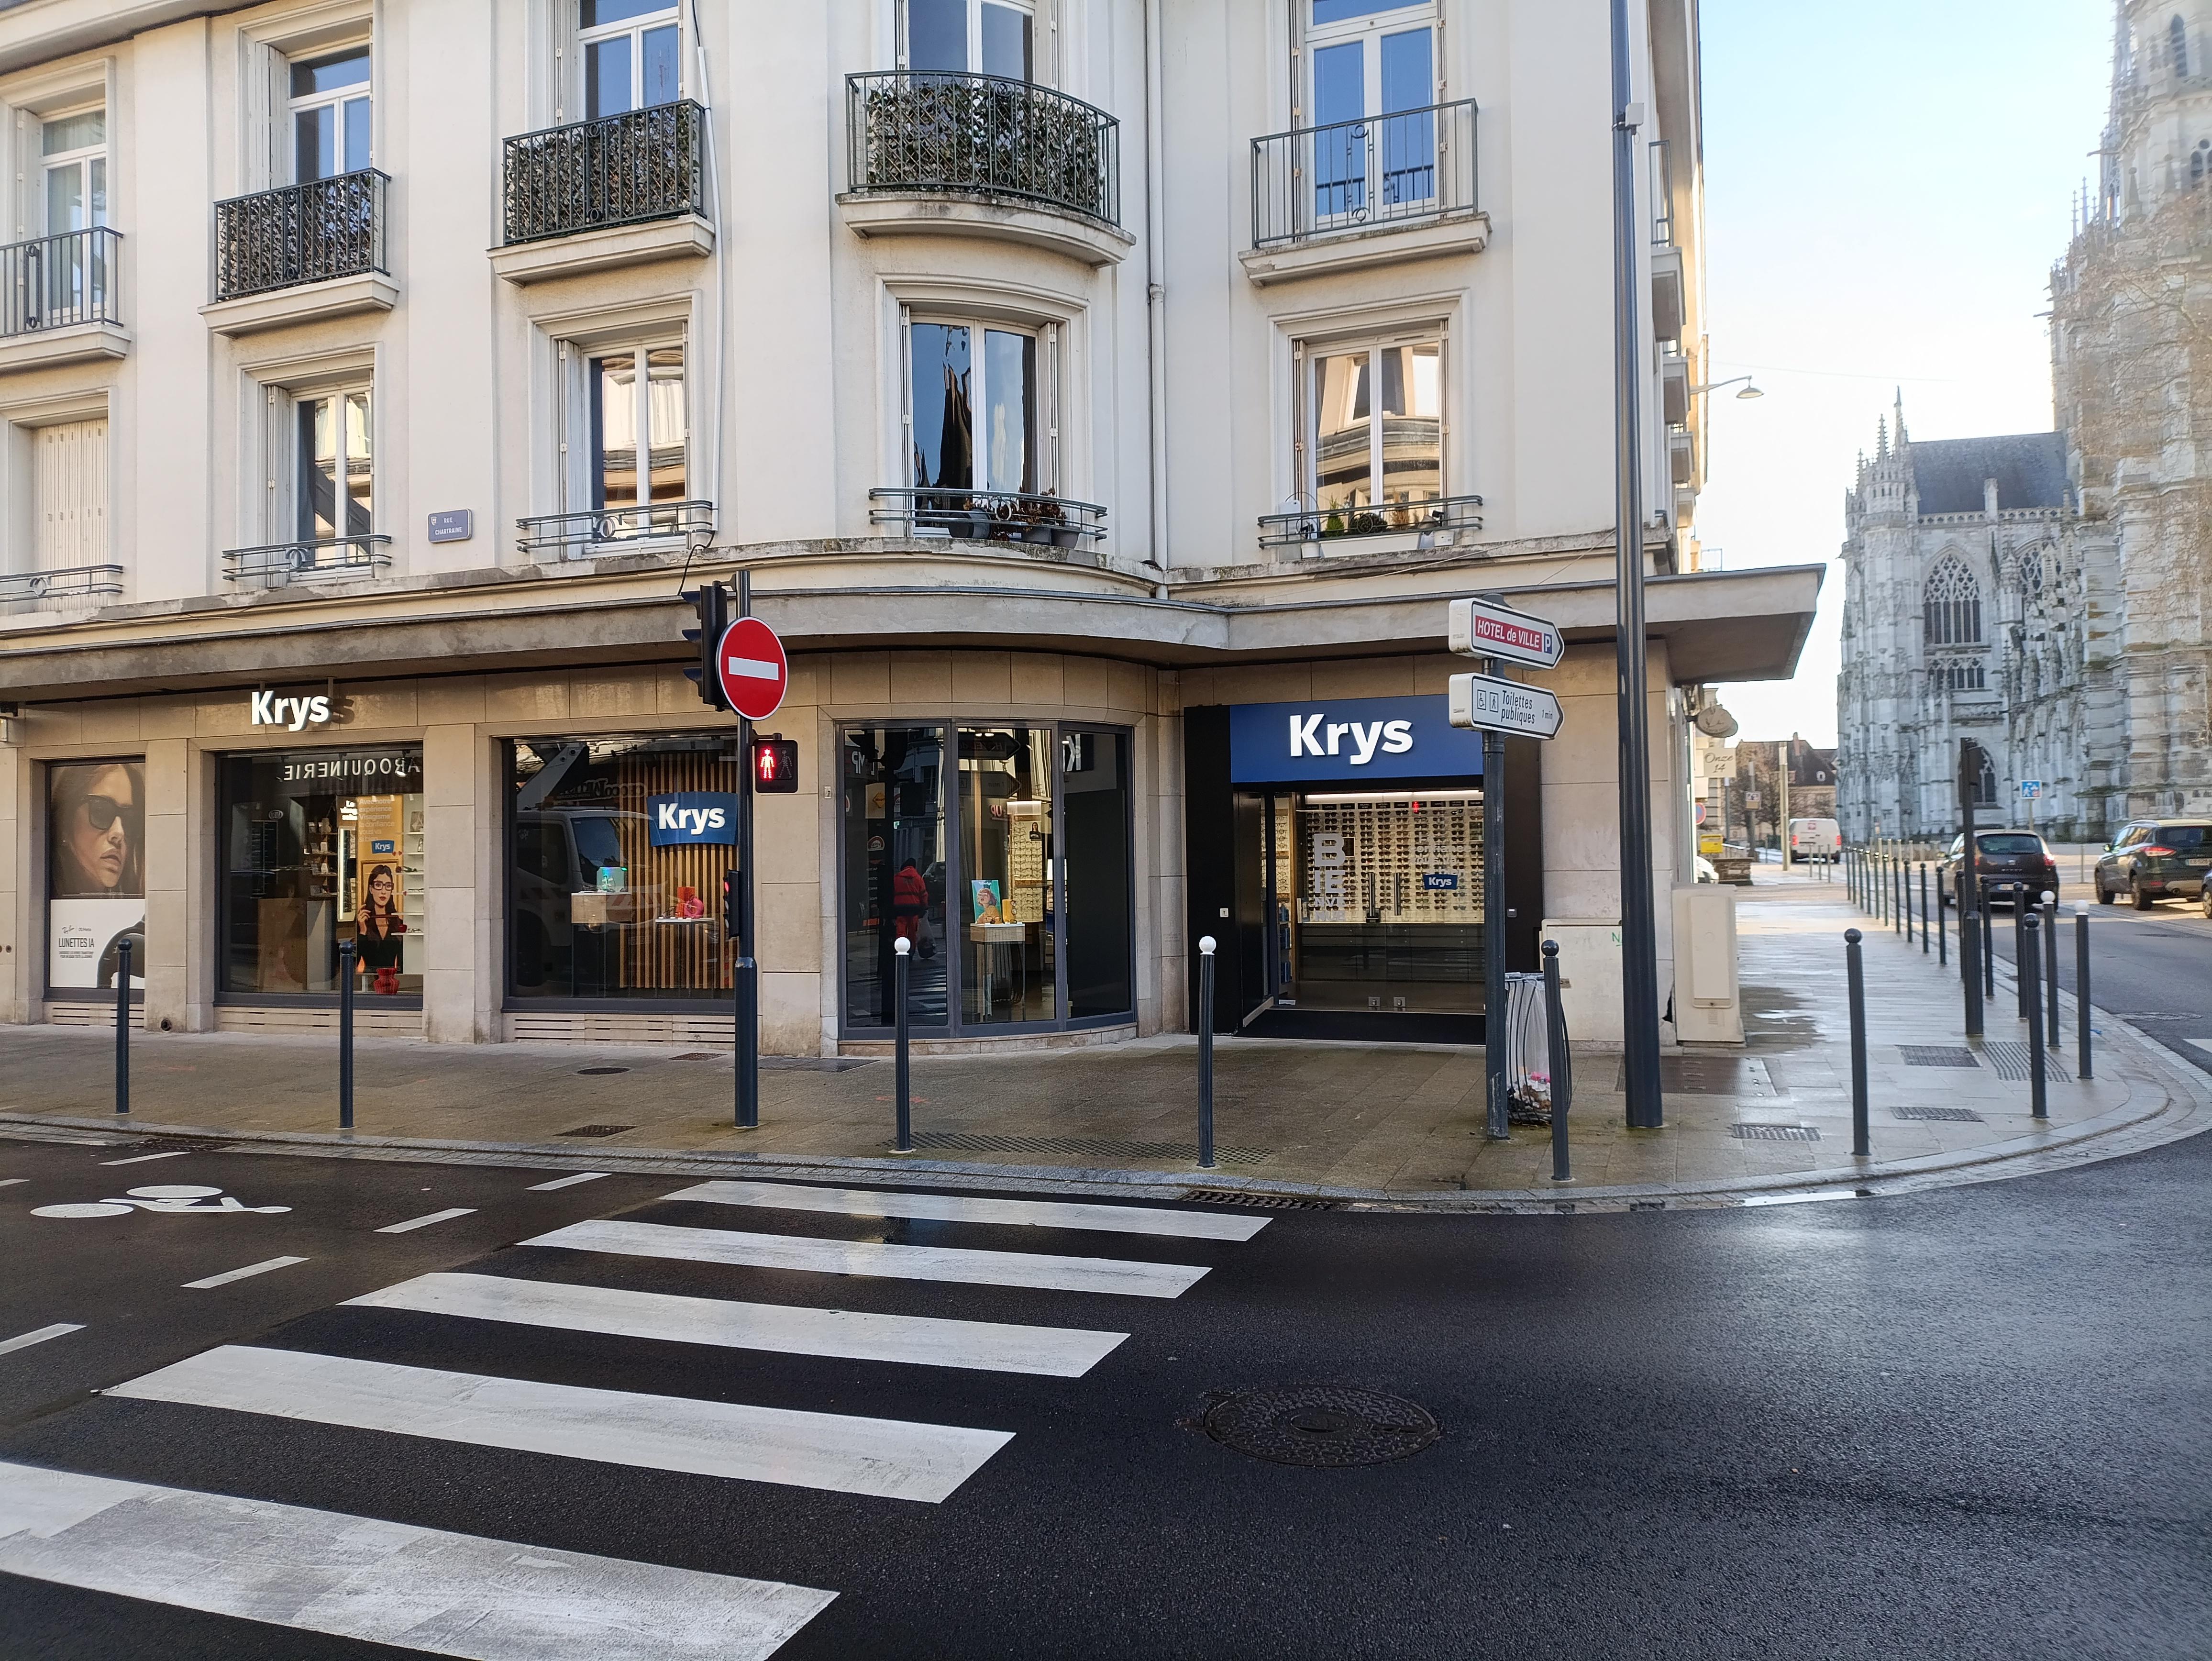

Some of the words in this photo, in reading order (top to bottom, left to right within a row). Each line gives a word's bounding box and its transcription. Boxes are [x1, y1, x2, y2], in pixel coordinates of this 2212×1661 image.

[435, 527, 462, 535] CHARTRAINE
[1477, 620, 1505, 640] HOTEL
[1507, 628, 1516, 642] de
[1518, 630, 1540, 648] VILLE
[1502, 690, 1532, 709] Toilettes
[252, 690, 330, 731] Krys
[1501, 707, 1535, 725] publiques
[1542, 709, 1545, 718] 1
[1290, 714, 1413, 764] Krys
[1704, 753, 1734, 763] Onze
[1713, 764, 1726, 773] 14
[659, 803, 725, 835] Krys
[375, 842, 390, 851] Krys
[1314, 833, 1346, 866] B
[1315, 870, 1346, 893] IE
[1429, 877, 1452, 887] Krys
[59, 938, 87, 947] LUNETTES
[88, 938, 94, 947] IA
